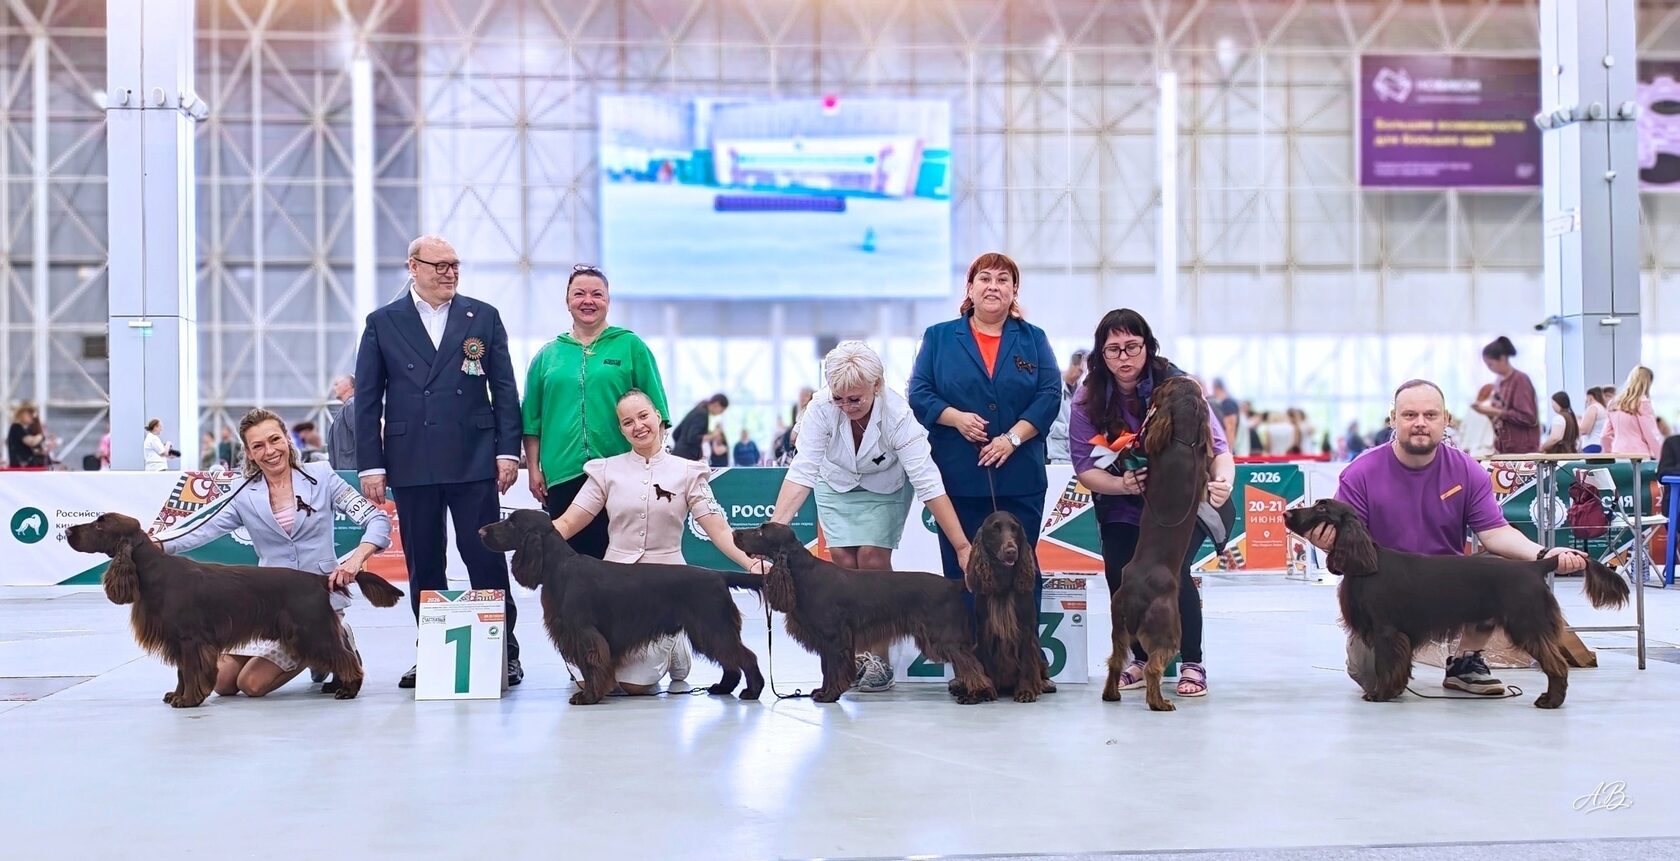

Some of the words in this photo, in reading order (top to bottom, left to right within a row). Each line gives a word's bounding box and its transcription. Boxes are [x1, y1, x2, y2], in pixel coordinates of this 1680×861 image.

[1250, 472, 1281, 483] 2026
[732, 504, 798, 518] РОСС
[1248, 501, 1282, 512] 20-21
[445, 624, 472, 694] 1
